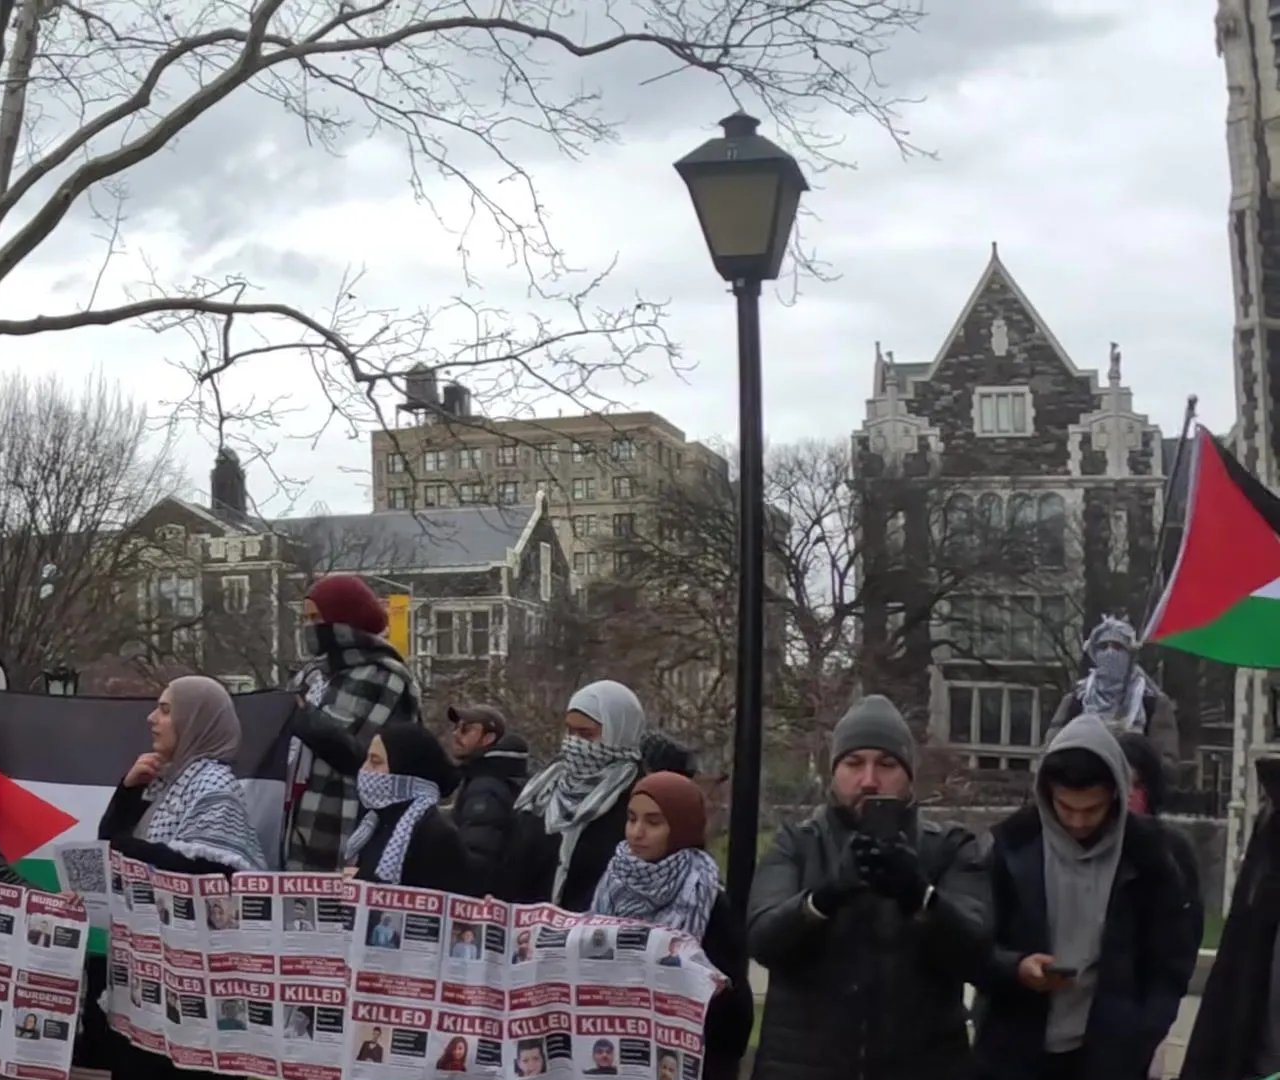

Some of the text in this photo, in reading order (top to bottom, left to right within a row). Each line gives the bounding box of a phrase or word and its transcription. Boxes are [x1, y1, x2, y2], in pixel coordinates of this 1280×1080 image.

[370, 889, 439, 911] KILLED
[16, 988, 73, 1006] MURDERED
[214, 981, 270, 997] KILLED
[284, 986, 343, 1002] KILLED
[357, 1004, 427, 1026] KILLED
[442, 1014, 500, 1036] KILLED
[510, 1013, 570, 1036] KILLED
[580, 1017, 649, 1034] KILLED
[655, 1025, 701, 1051] KILLED
